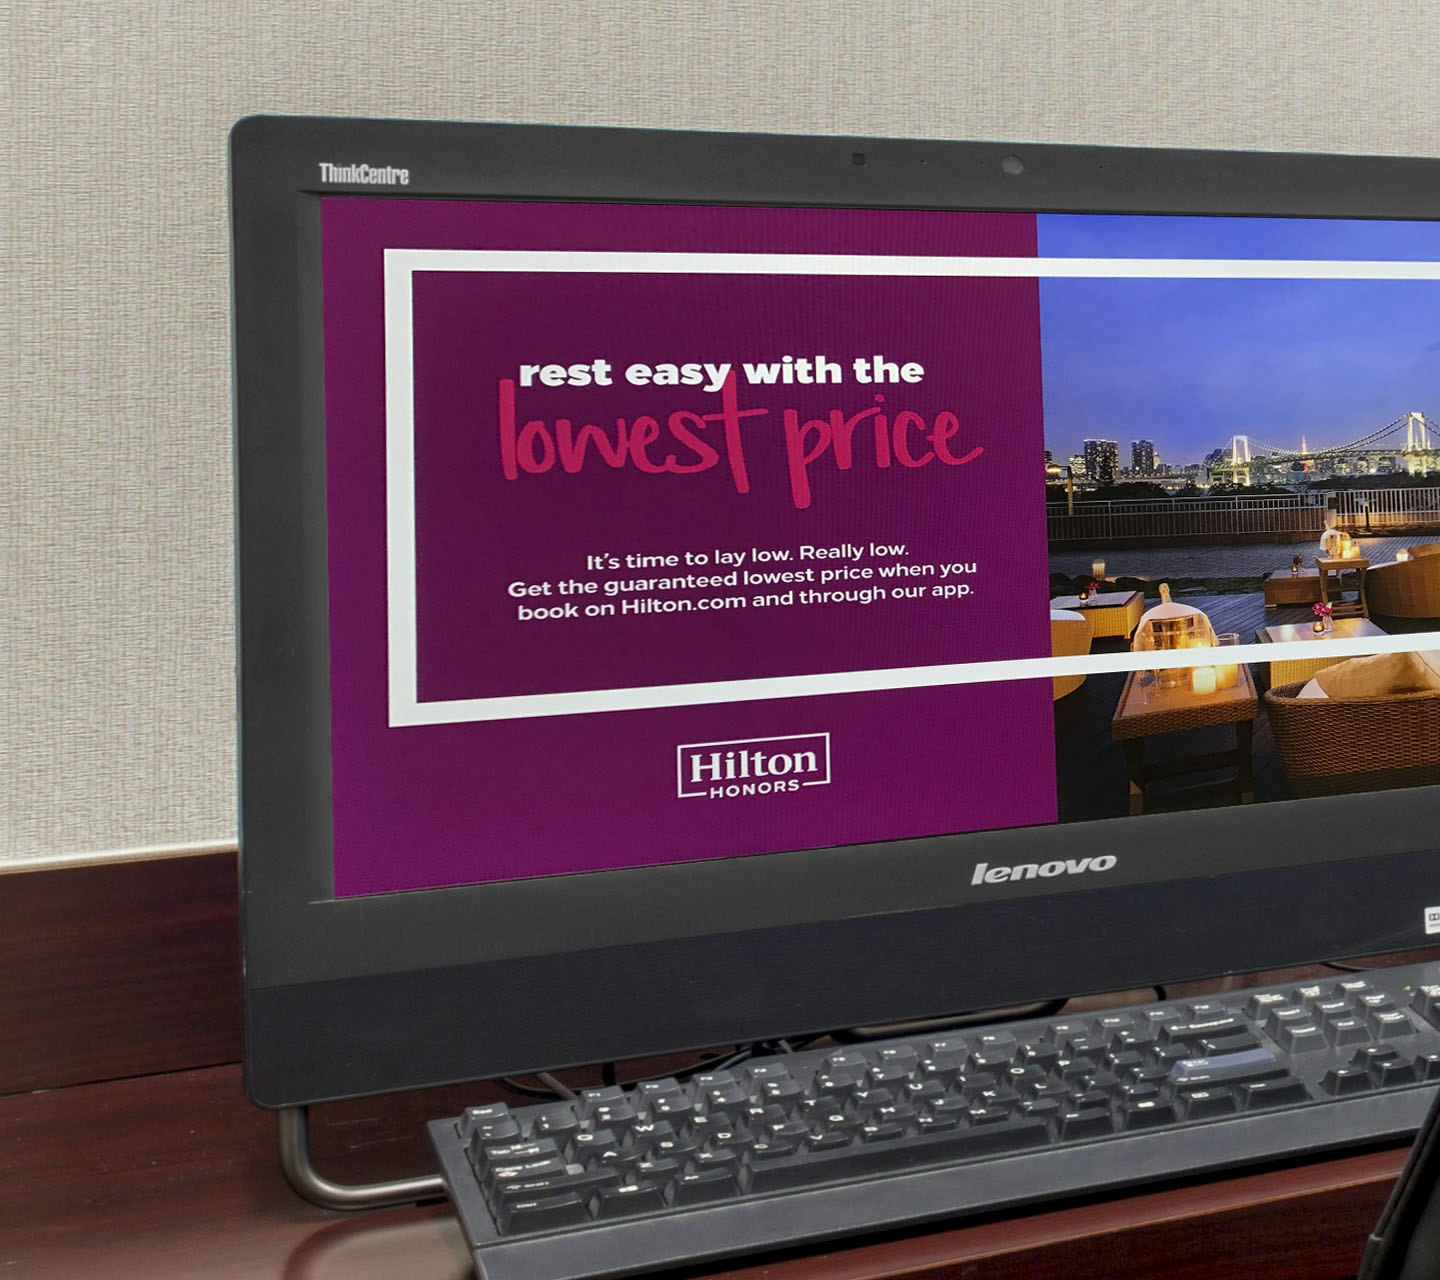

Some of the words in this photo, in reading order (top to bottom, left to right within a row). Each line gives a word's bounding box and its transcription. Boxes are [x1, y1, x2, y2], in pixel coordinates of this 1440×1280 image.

[318, 162, 410, 186] ThinkCentre
[519, 359, 613, 387] rest
[624, 362, 732, 393] easy
[742, 355, 843, 384] with
[853, 355, 925, 384] the
[499, 370, 769, 494] lowest
[783, 393, 985, 510] price
[586, 552, 621, 571] It's
[625, 553, 679, 569] time
[684, 551, 708, 567] to
[714, 549, 746, 568] lay
[751, 547, 794, 563] low.
[799, 543, 864, 561] Really
[870, 542, 910, 557] low.
[507, 581, 552, 598] Get
[558, 579, 598, 595] the
[603, 571, 738, 597] guaranteed
[743, 568, 815, 586] lowest
[820, 566, 874, 585] price
[878, 562, 935, 578] when
[939, 562, 977, 578] you
[517, 603, 579, 621] book
[584, 603, 615, 617] on
[621, 596, 747, 615] Hilton.com
[751, 590, 794, 608] and
[799, 585, 887, 604] through
[891, 585, 927, 599] our
[931, 583, 975, 599] app.
[689, 749, 819, 783] Hilton
[709, 778, 800, 800] HONORS
[970, 854, 1118, 886] lenovo
